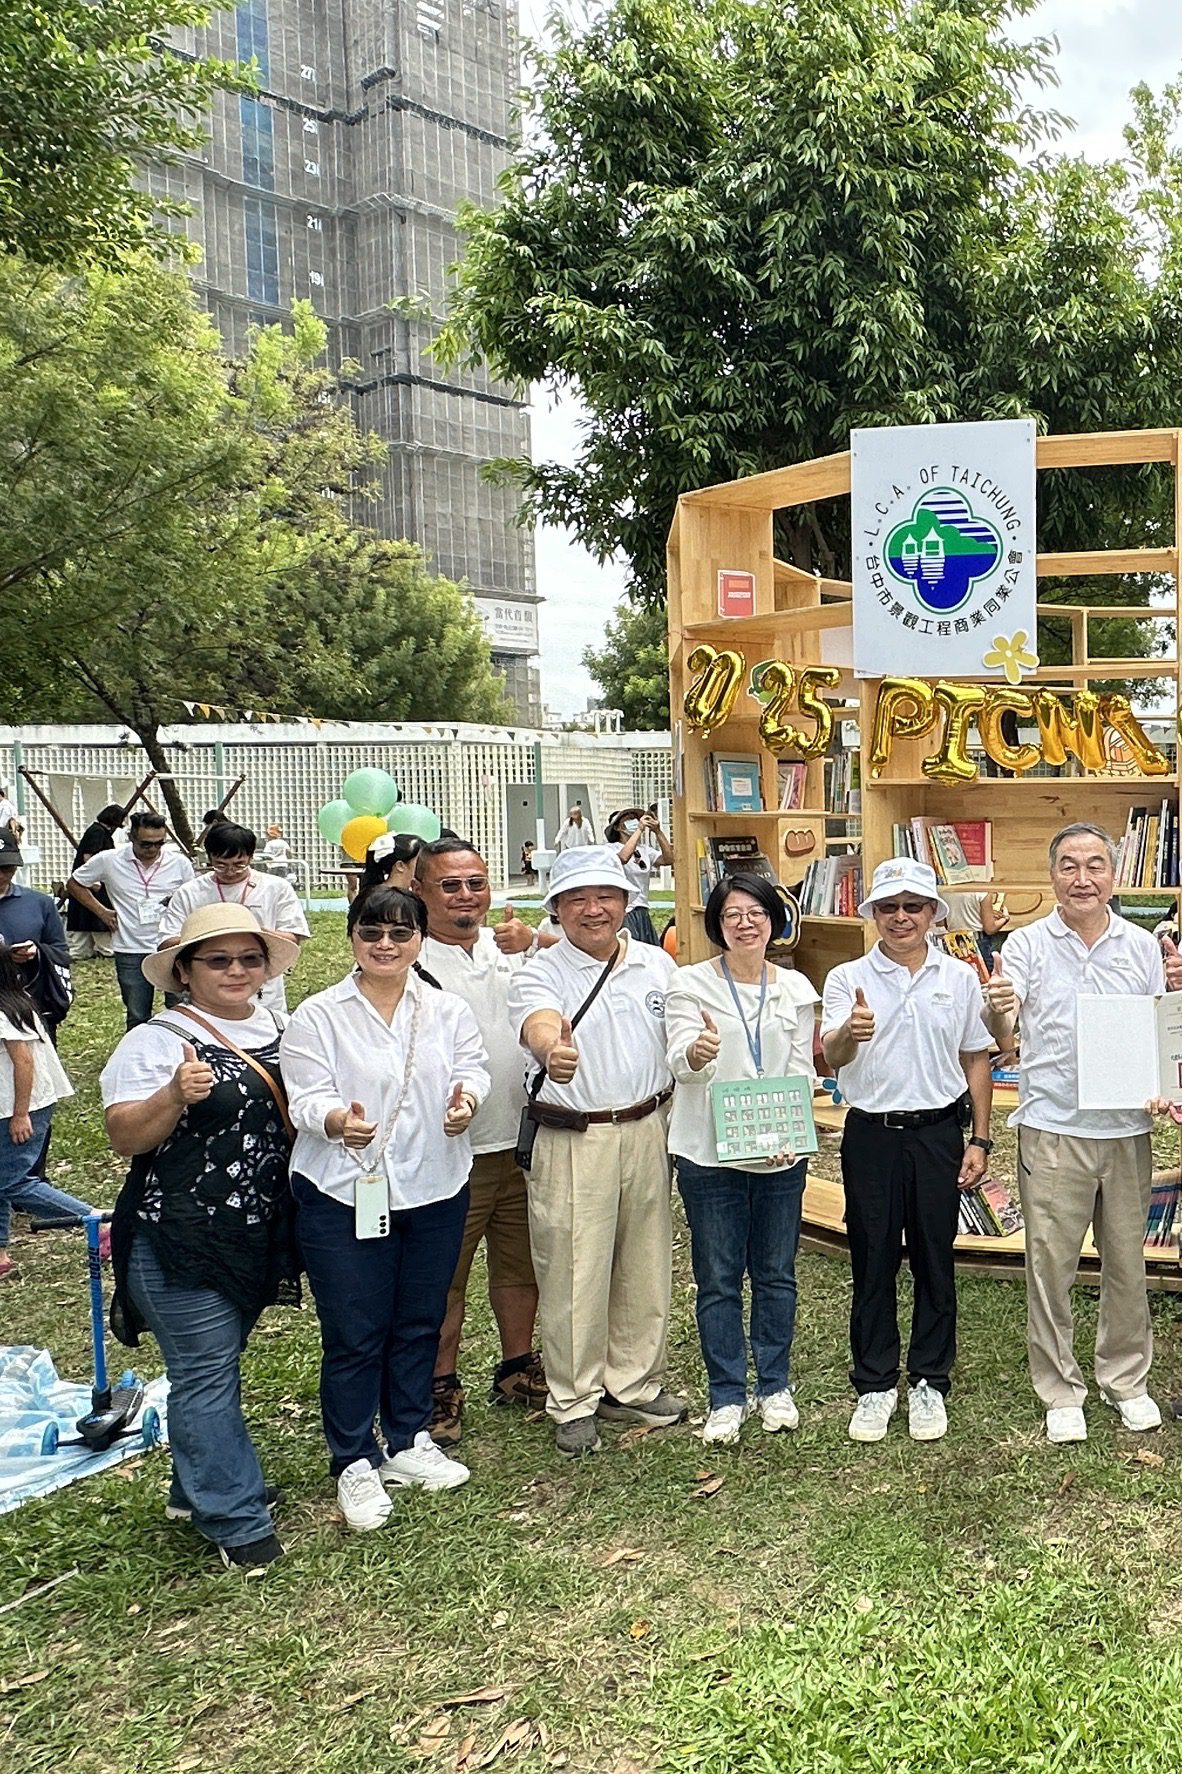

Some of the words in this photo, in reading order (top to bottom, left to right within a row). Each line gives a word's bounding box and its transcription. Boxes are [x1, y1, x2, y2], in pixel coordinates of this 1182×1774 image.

[863, 485, 911, 538] L.C.A.
[919, 465, 940, 485] OF
[951, 465, 1022, 532] TAICHUNG
